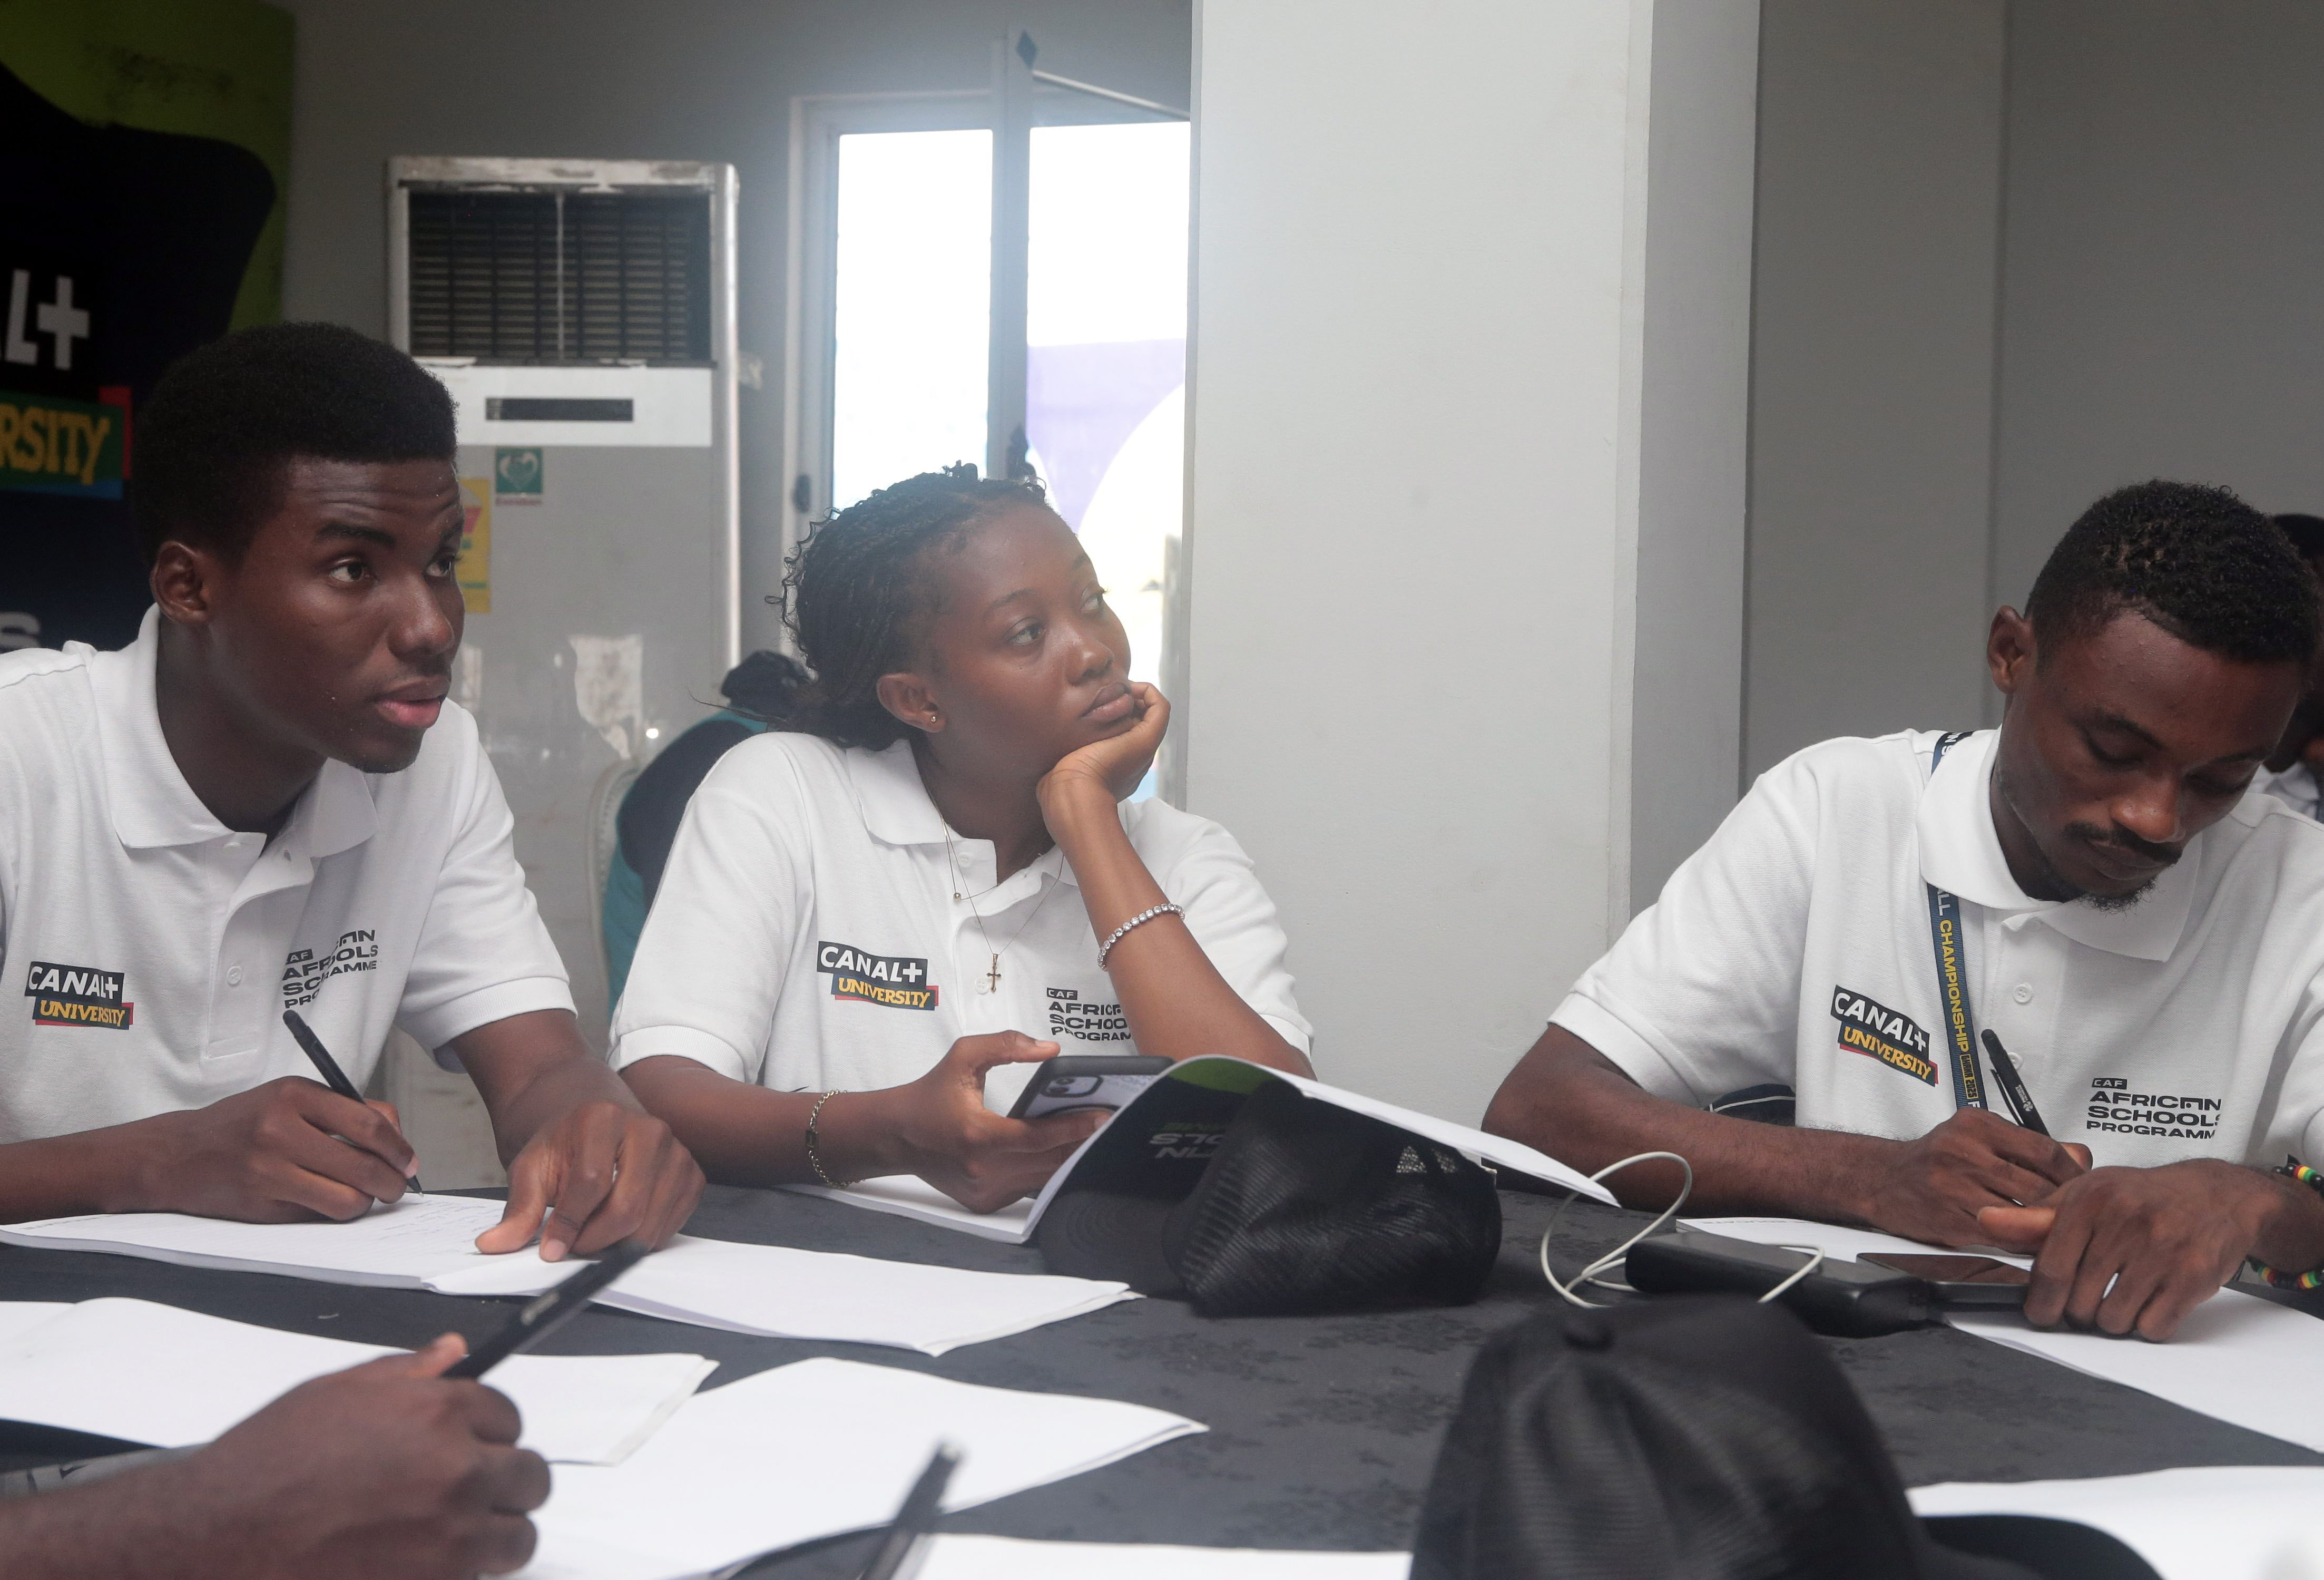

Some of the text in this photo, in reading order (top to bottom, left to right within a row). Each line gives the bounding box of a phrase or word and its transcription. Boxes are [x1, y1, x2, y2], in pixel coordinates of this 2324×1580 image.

[820, 946, 923, 983] CANAL+
[28, 966, 119, 999] CANAL+
[838, 977, 930, 1008] UNIVERSITY
[1048, 990, 1074, 998] CAF
[1940, 920, 1969, 1052] CHAMPIONSHIP
[40, 1000, 125, 1027] UNIVERSITY
[1835, 992, 1926, 1052] CANAL+
[1844, 1026, 1931, 1080] UNIVERSITY
[2090, 1091, 2221, 1110] AFRICAN
